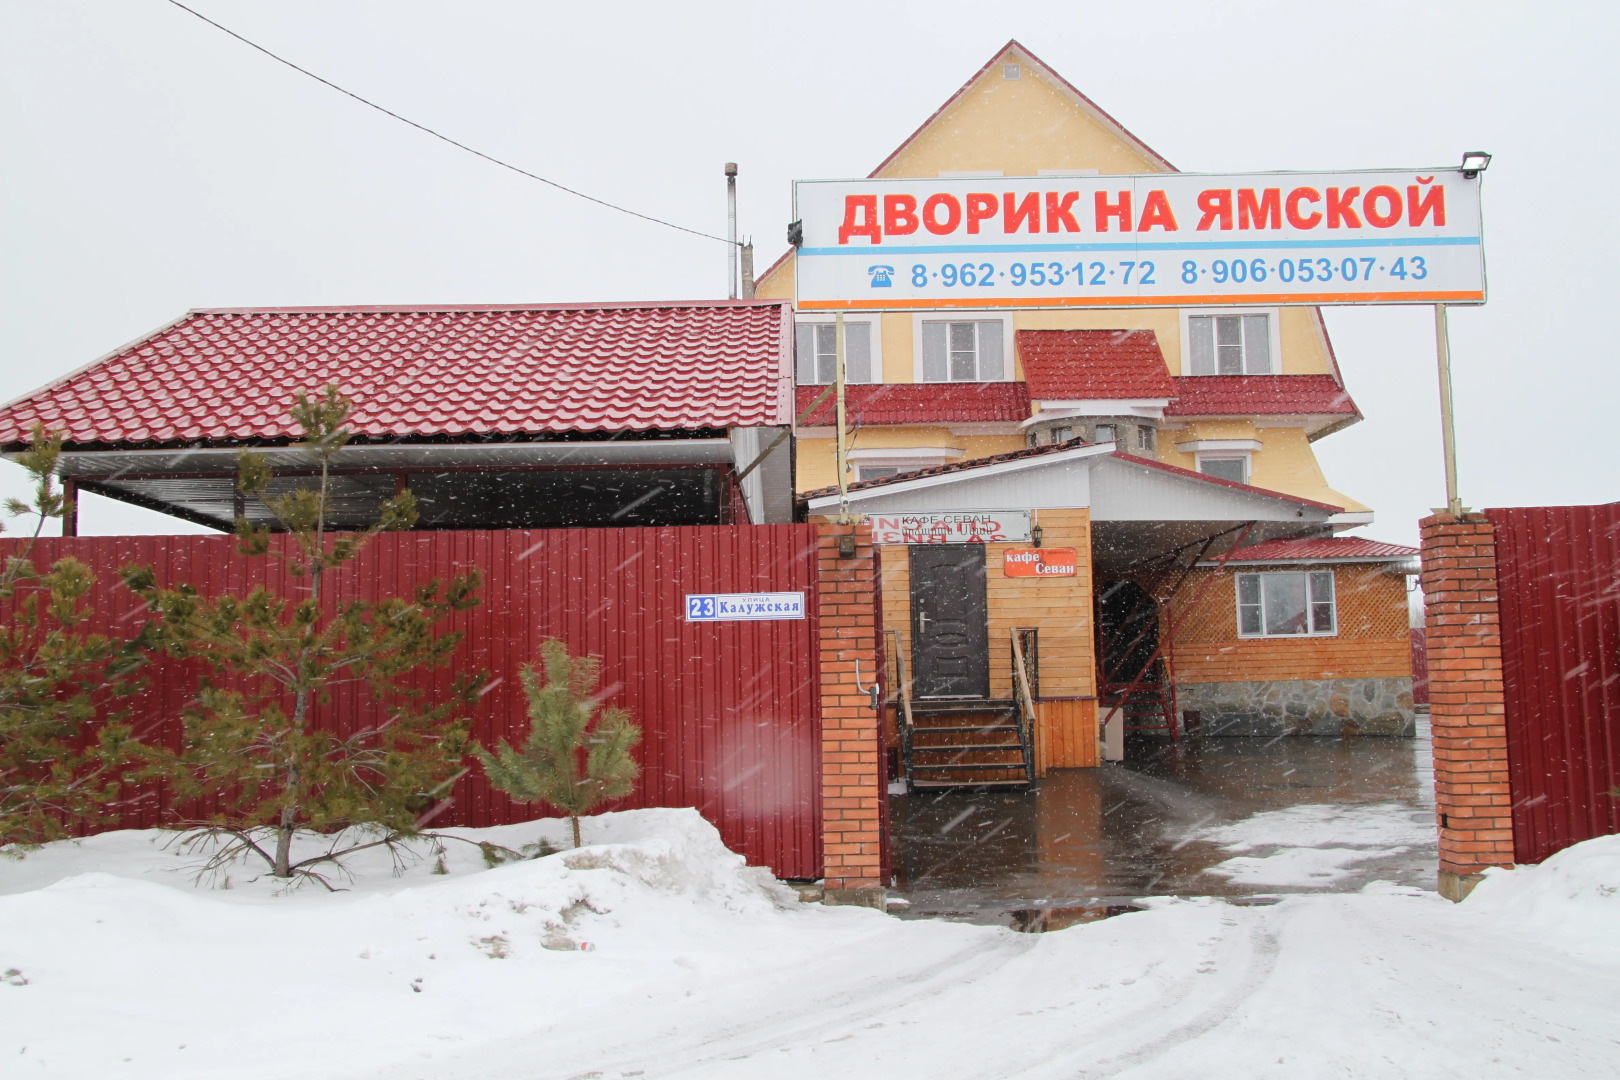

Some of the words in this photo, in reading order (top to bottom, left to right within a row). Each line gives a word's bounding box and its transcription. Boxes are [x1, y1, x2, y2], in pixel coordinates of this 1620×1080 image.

[838, 190, 1080, 245] ДВОРИК
[1095, 189, 1179, 233] НА
[1196, 175, 1446, 231] ЯМСКОЙ
[902, 515, 938, 525] КАФЕ
[943, 514, 991, 524] СЕВАН
[1006, 551, 1040, 565] кафе
[1035, 562, 1074, 575] Севан
[691, 598, 714, 616] 23
[720, 602, 799, 615] Калужская
